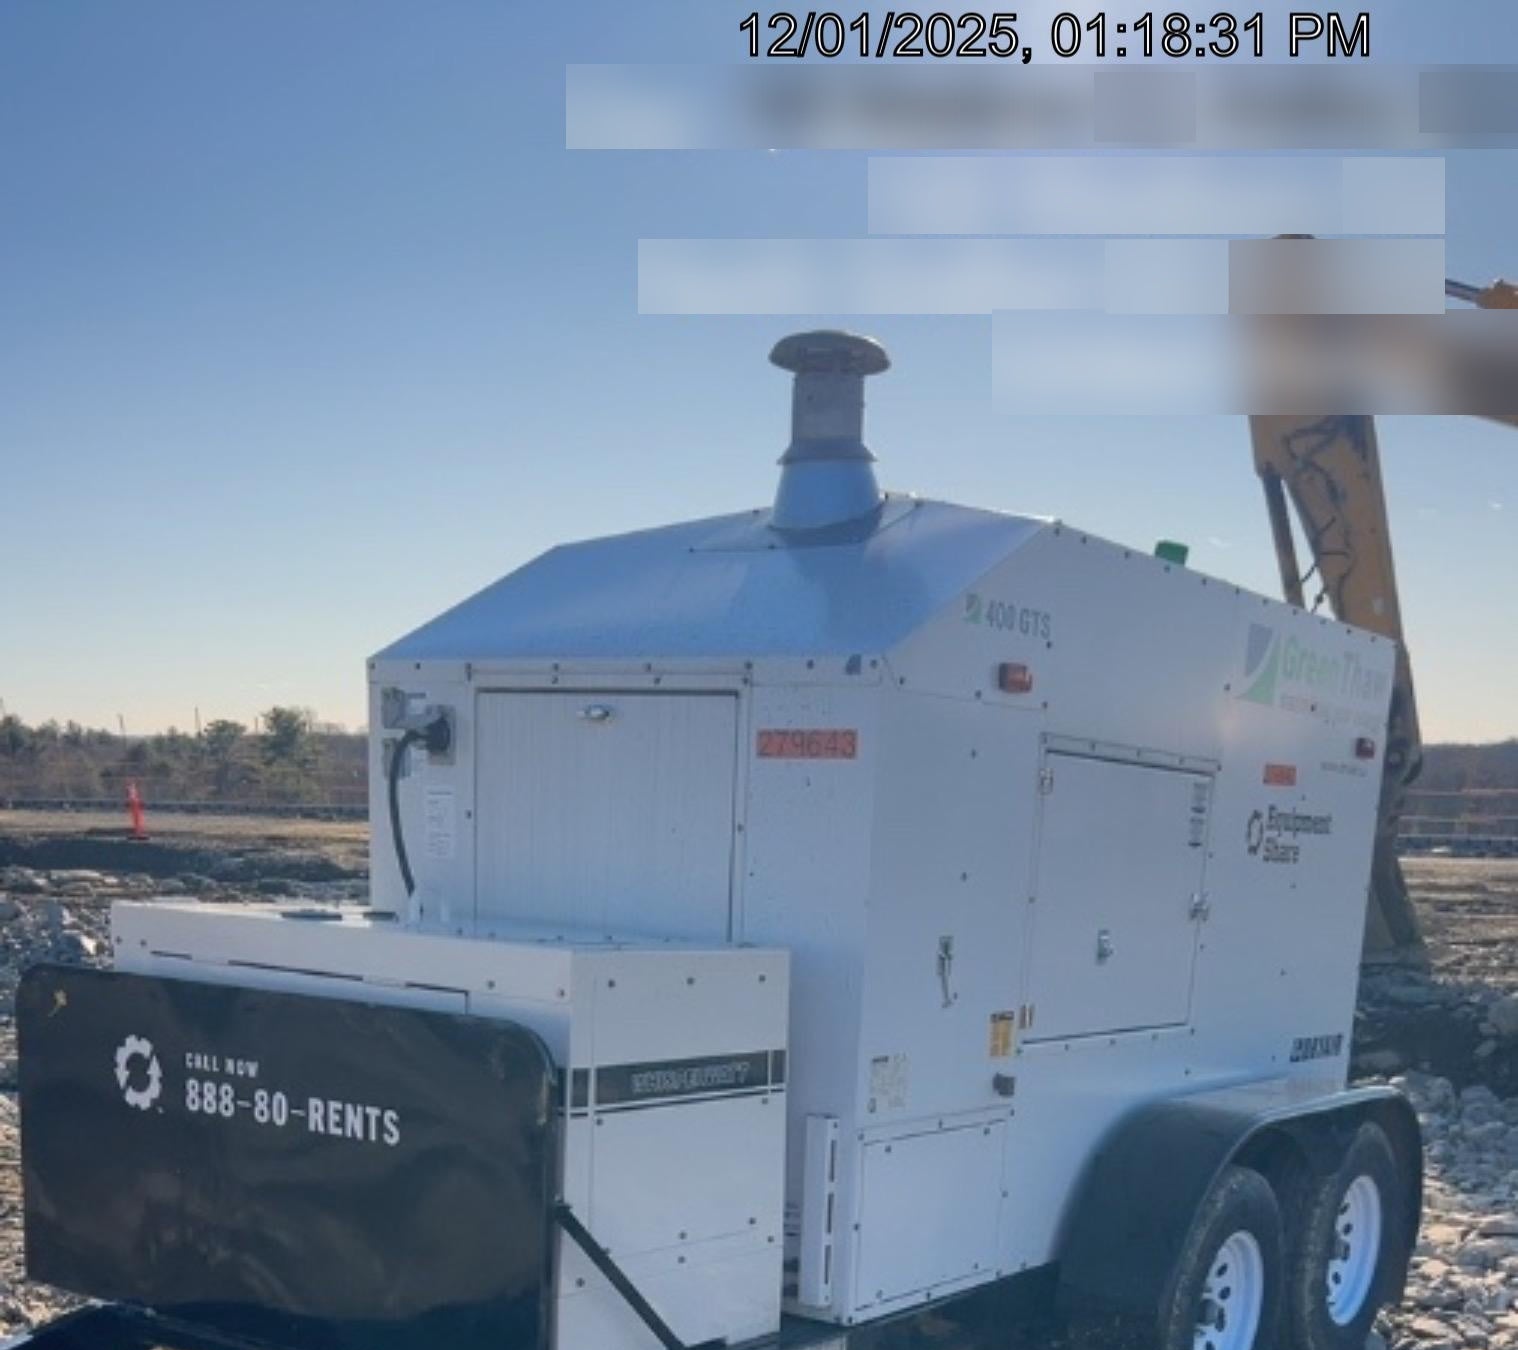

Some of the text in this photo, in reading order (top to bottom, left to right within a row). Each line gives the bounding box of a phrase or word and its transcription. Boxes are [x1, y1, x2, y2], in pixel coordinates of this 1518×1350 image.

[985, 599, 1051, 640] 400 GTS
[756, 729, 857, 758] 279643
[1265, 804, 1332, 838] Equipment
[1263, 836, 1299, 864] Share
[185, 1052, 259, 1078] CALL NOW
[185, 1078, 400, 1146] 888-80-RENTS
